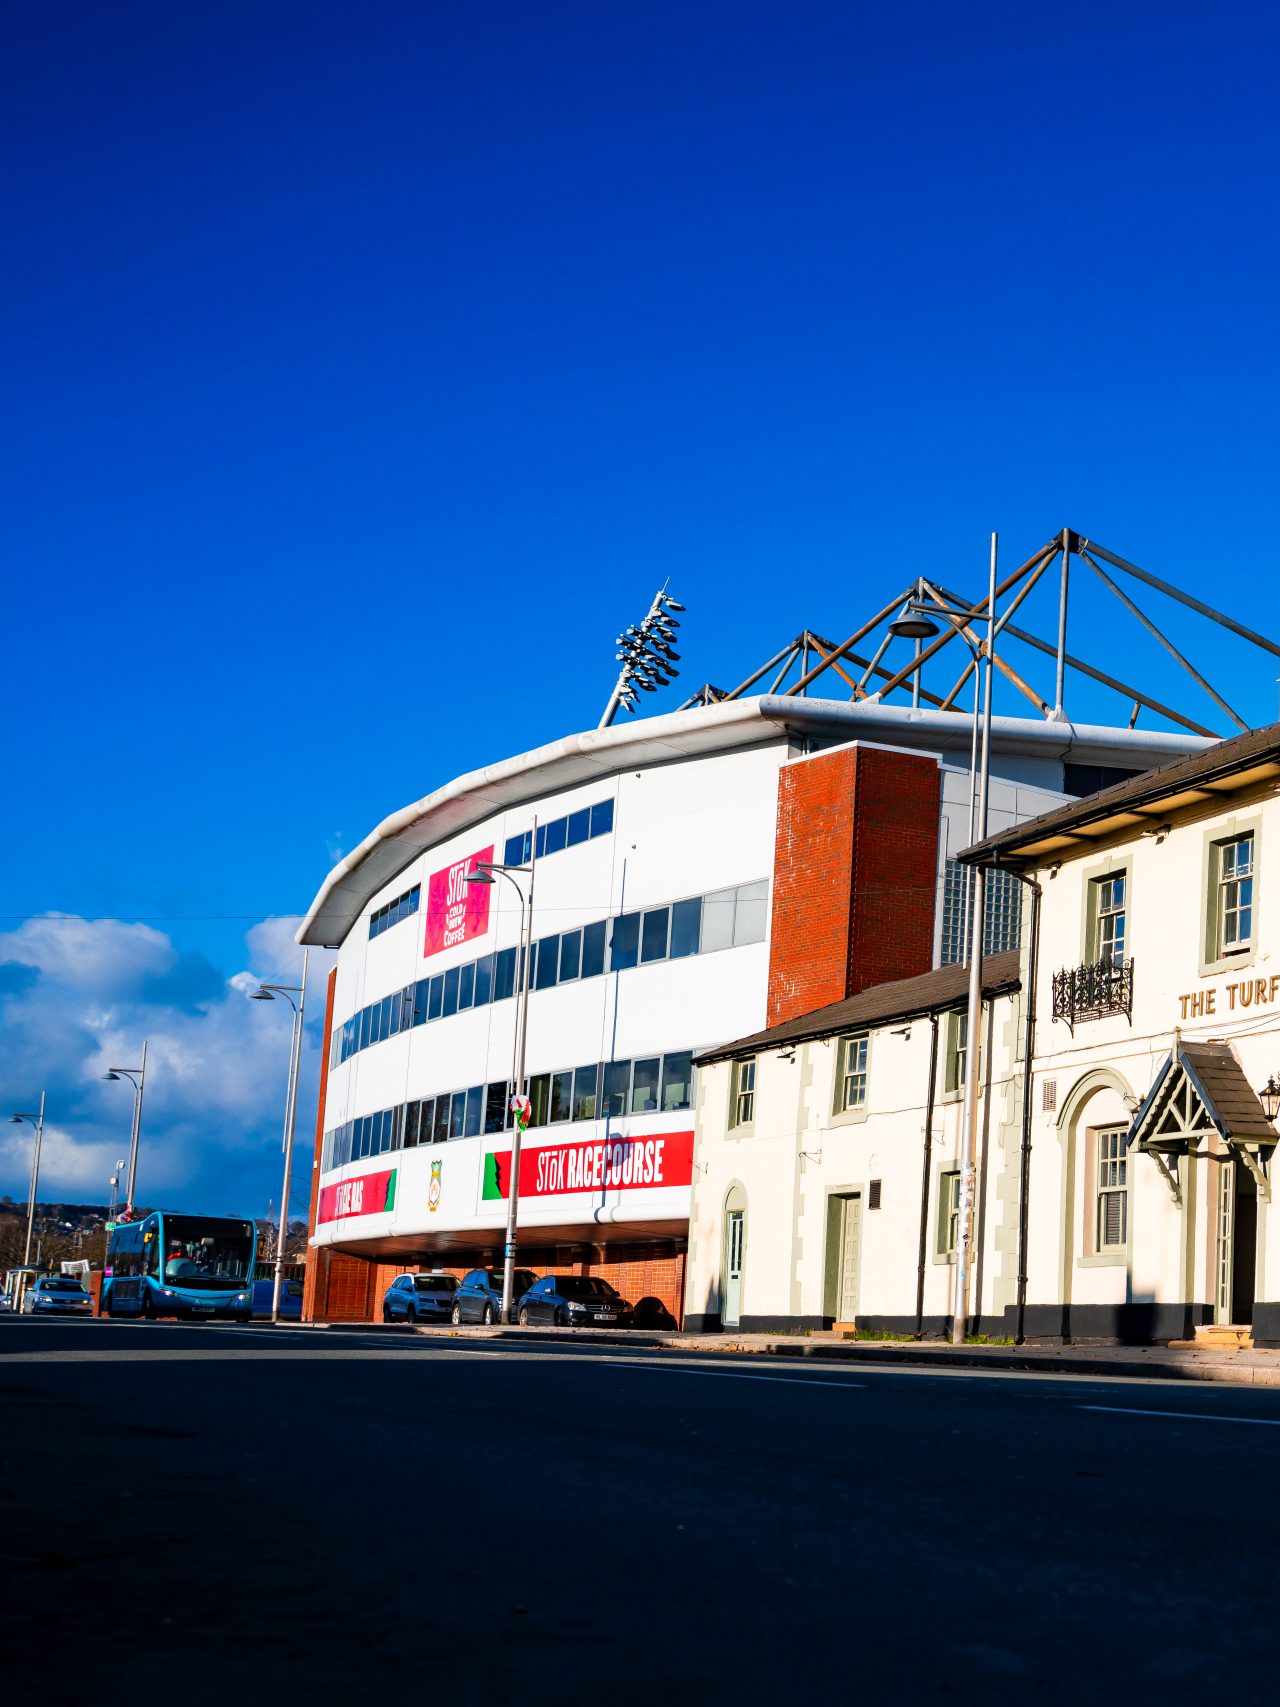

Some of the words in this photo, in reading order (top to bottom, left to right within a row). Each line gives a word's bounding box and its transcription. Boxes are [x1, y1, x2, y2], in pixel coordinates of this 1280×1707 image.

[449, 903, 463, 918] COLD
[444, 923, 466, 947] COFFEE
[1178, 988, 1216, 1020] THE
[1225, 974, 1280, 1010] TURF
[566, 1140, 665, 1188] RACECOURSE
